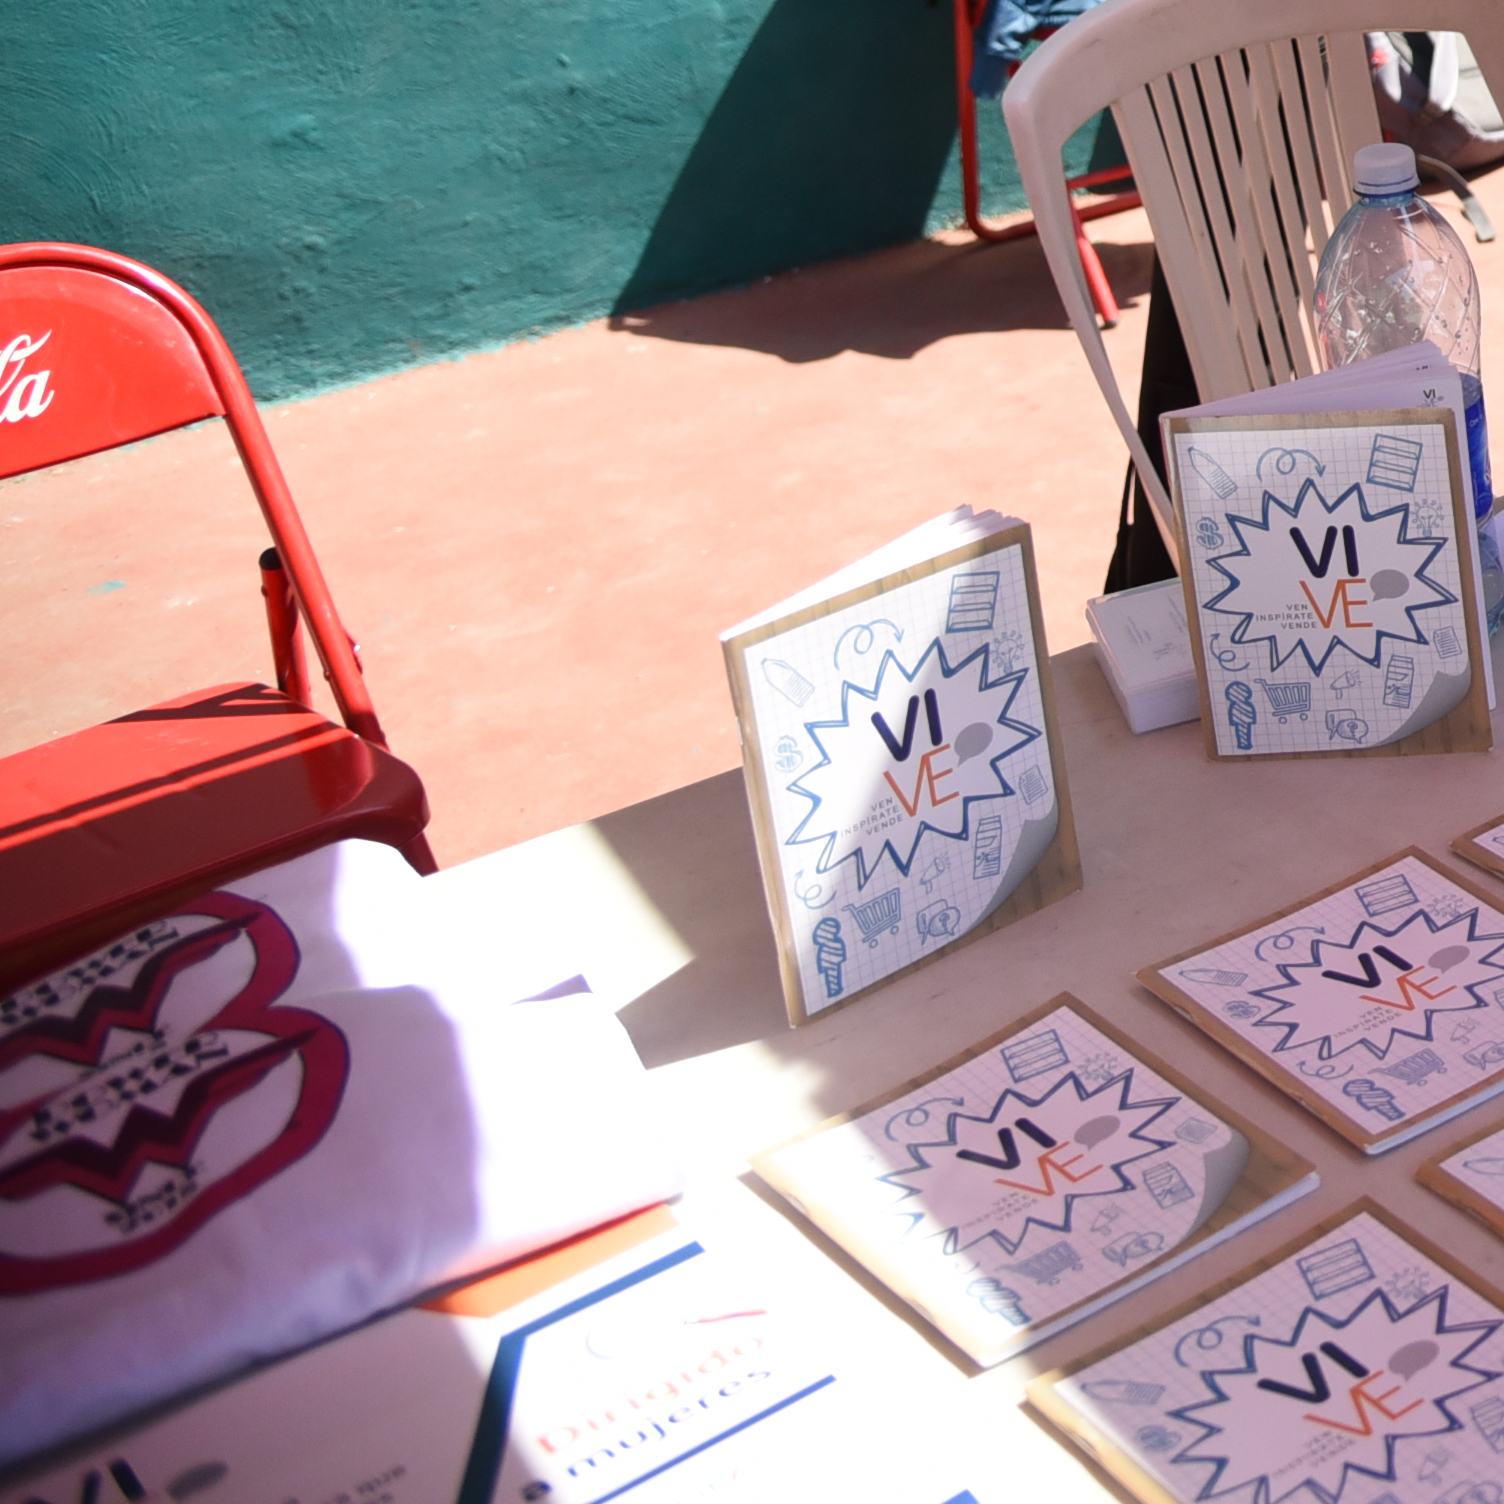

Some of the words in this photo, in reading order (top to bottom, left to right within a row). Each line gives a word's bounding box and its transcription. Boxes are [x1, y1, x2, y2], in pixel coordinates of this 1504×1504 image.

[1289, 525, 1359, 578] VI
[1255, 611, 1314, 622] INSPÍRATE
[1281, 622, 1318, 630] VENDE
[1299, 578, 1374, 629] VE
[871, 688, 943, 762] VI
[870, 797, 894, 812] VEN
[883, 744, 960, 818] VE
[866, 816, 905, 837] VENDE
[1321, 945, 1414, 988] VI
[1359, 965, 1457, 1011] VE
[956, 1118, 1057, 1170] VI
[994, 1141, 1104, 1196] VE
[1257, 1341, 1370, 1404] VI
[1302, 1369, 1425, 1436] VE
